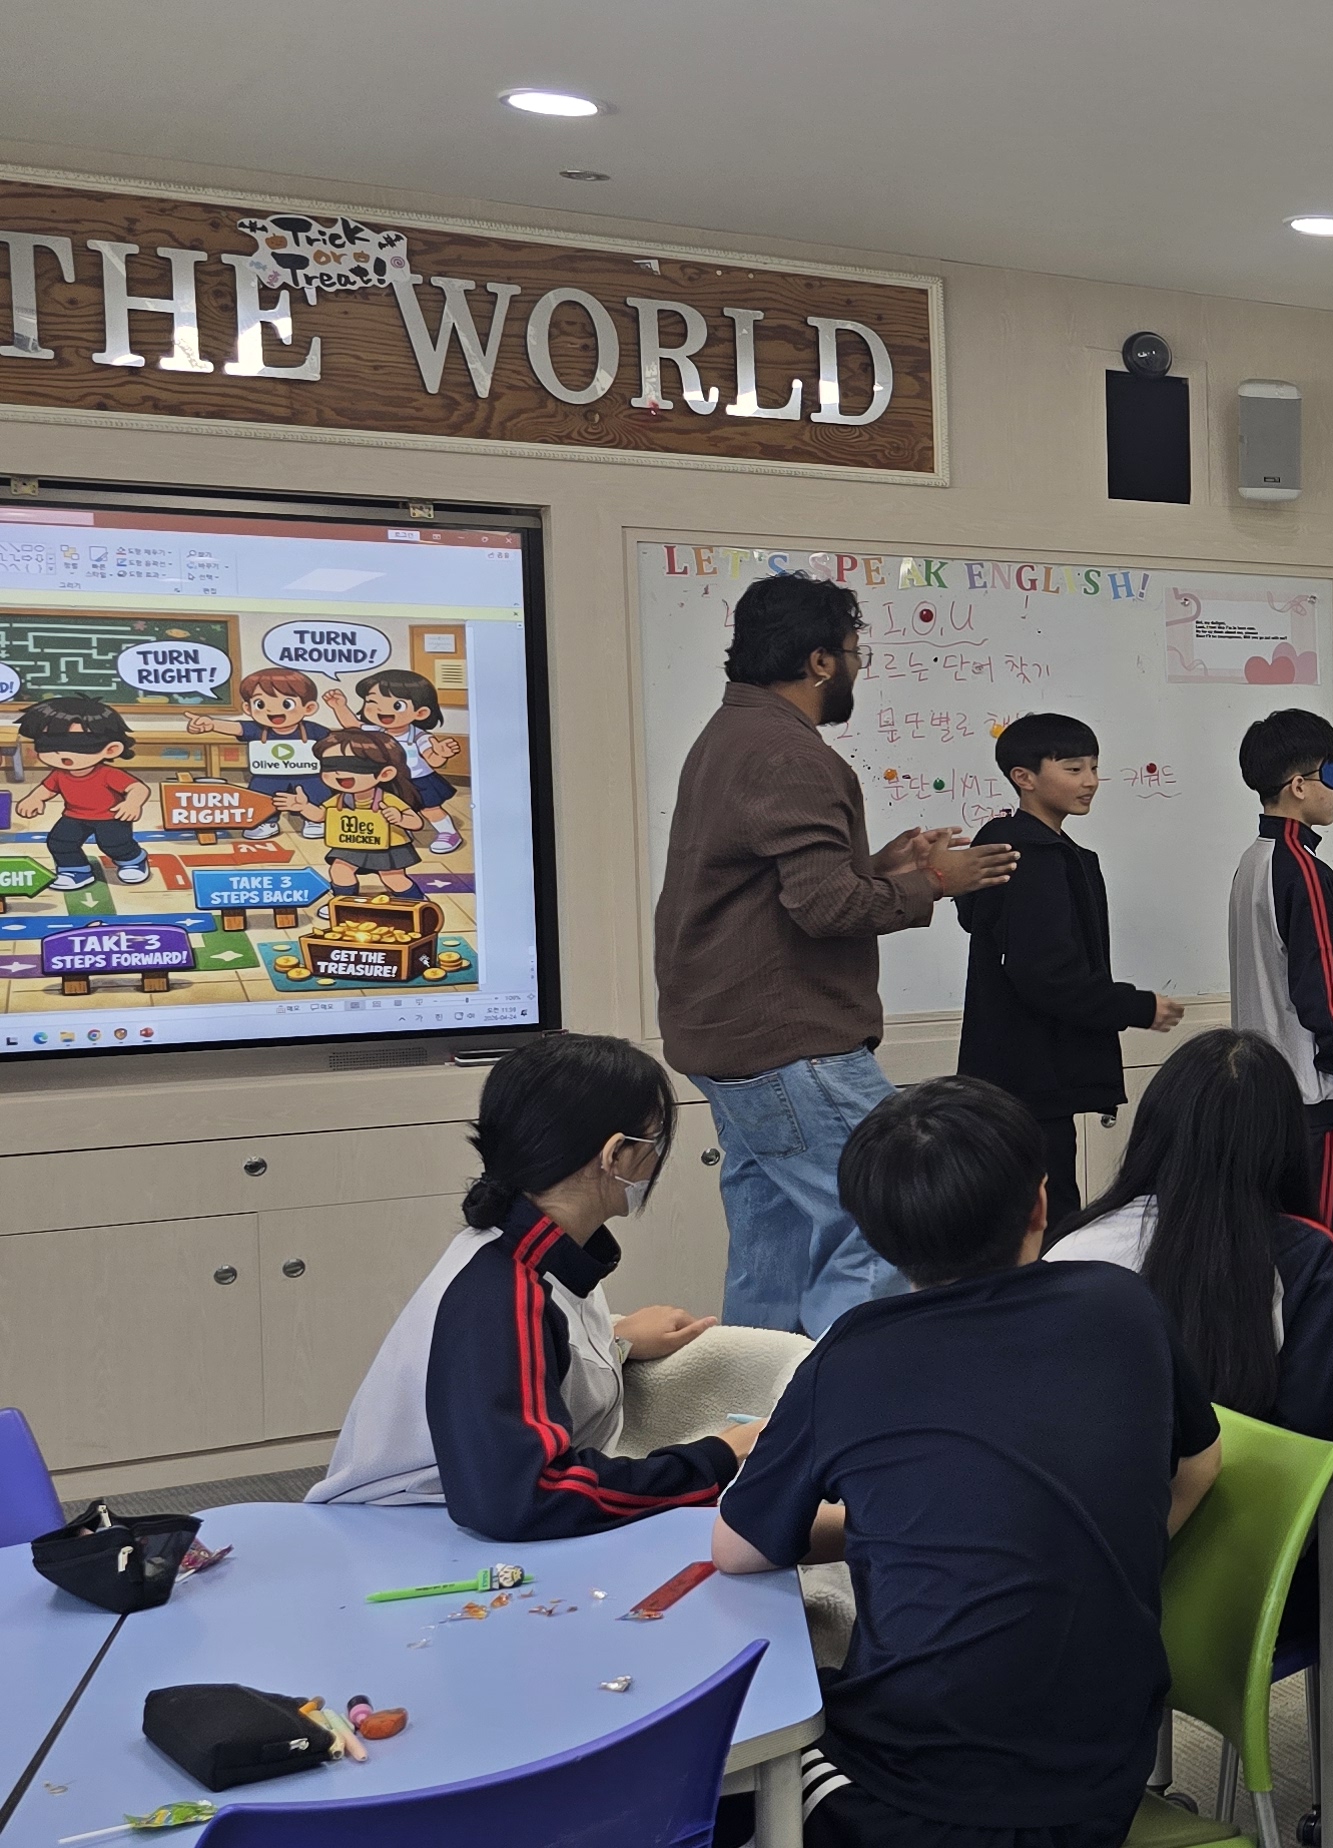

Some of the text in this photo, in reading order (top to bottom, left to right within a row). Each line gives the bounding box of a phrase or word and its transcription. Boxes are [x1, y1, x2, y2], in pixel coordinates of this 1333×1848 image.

[270, 217, 370, 248] Trick
[313, 250, 347, 266] or
[271, 252, 387, 287] Treat!
[0, 230, 893, 426] THE WORLD
[664, 545, 1150, 600] LET'S SPEAK ENGLISH!
[294, 630, 357, 646] TURN
[136, 649, 200, 666] TURN
[278, 647, 377, 664] AROUND!
[137, 667, 217, 684] RIGHT!
[1005, 654, 1051, 684] 찾기
[252, 760, 318, 770] Olive Young
[175, 792, 240, 808] TURN
[172, 808, 254, 824] RIGHT!
[339, 834, 381, 845] CHICKEN
[229, 876, 292, 889] TAKE 3
[210, 889, 310, 904] STEPS BACK!
[68, 932, 161, 952] TAKE 3
[51, 951, 188, 969] STEPS FORWARD!
[330, 949, 387, 964] GET THE
[316, 961, 398, 977] TREASURE!
